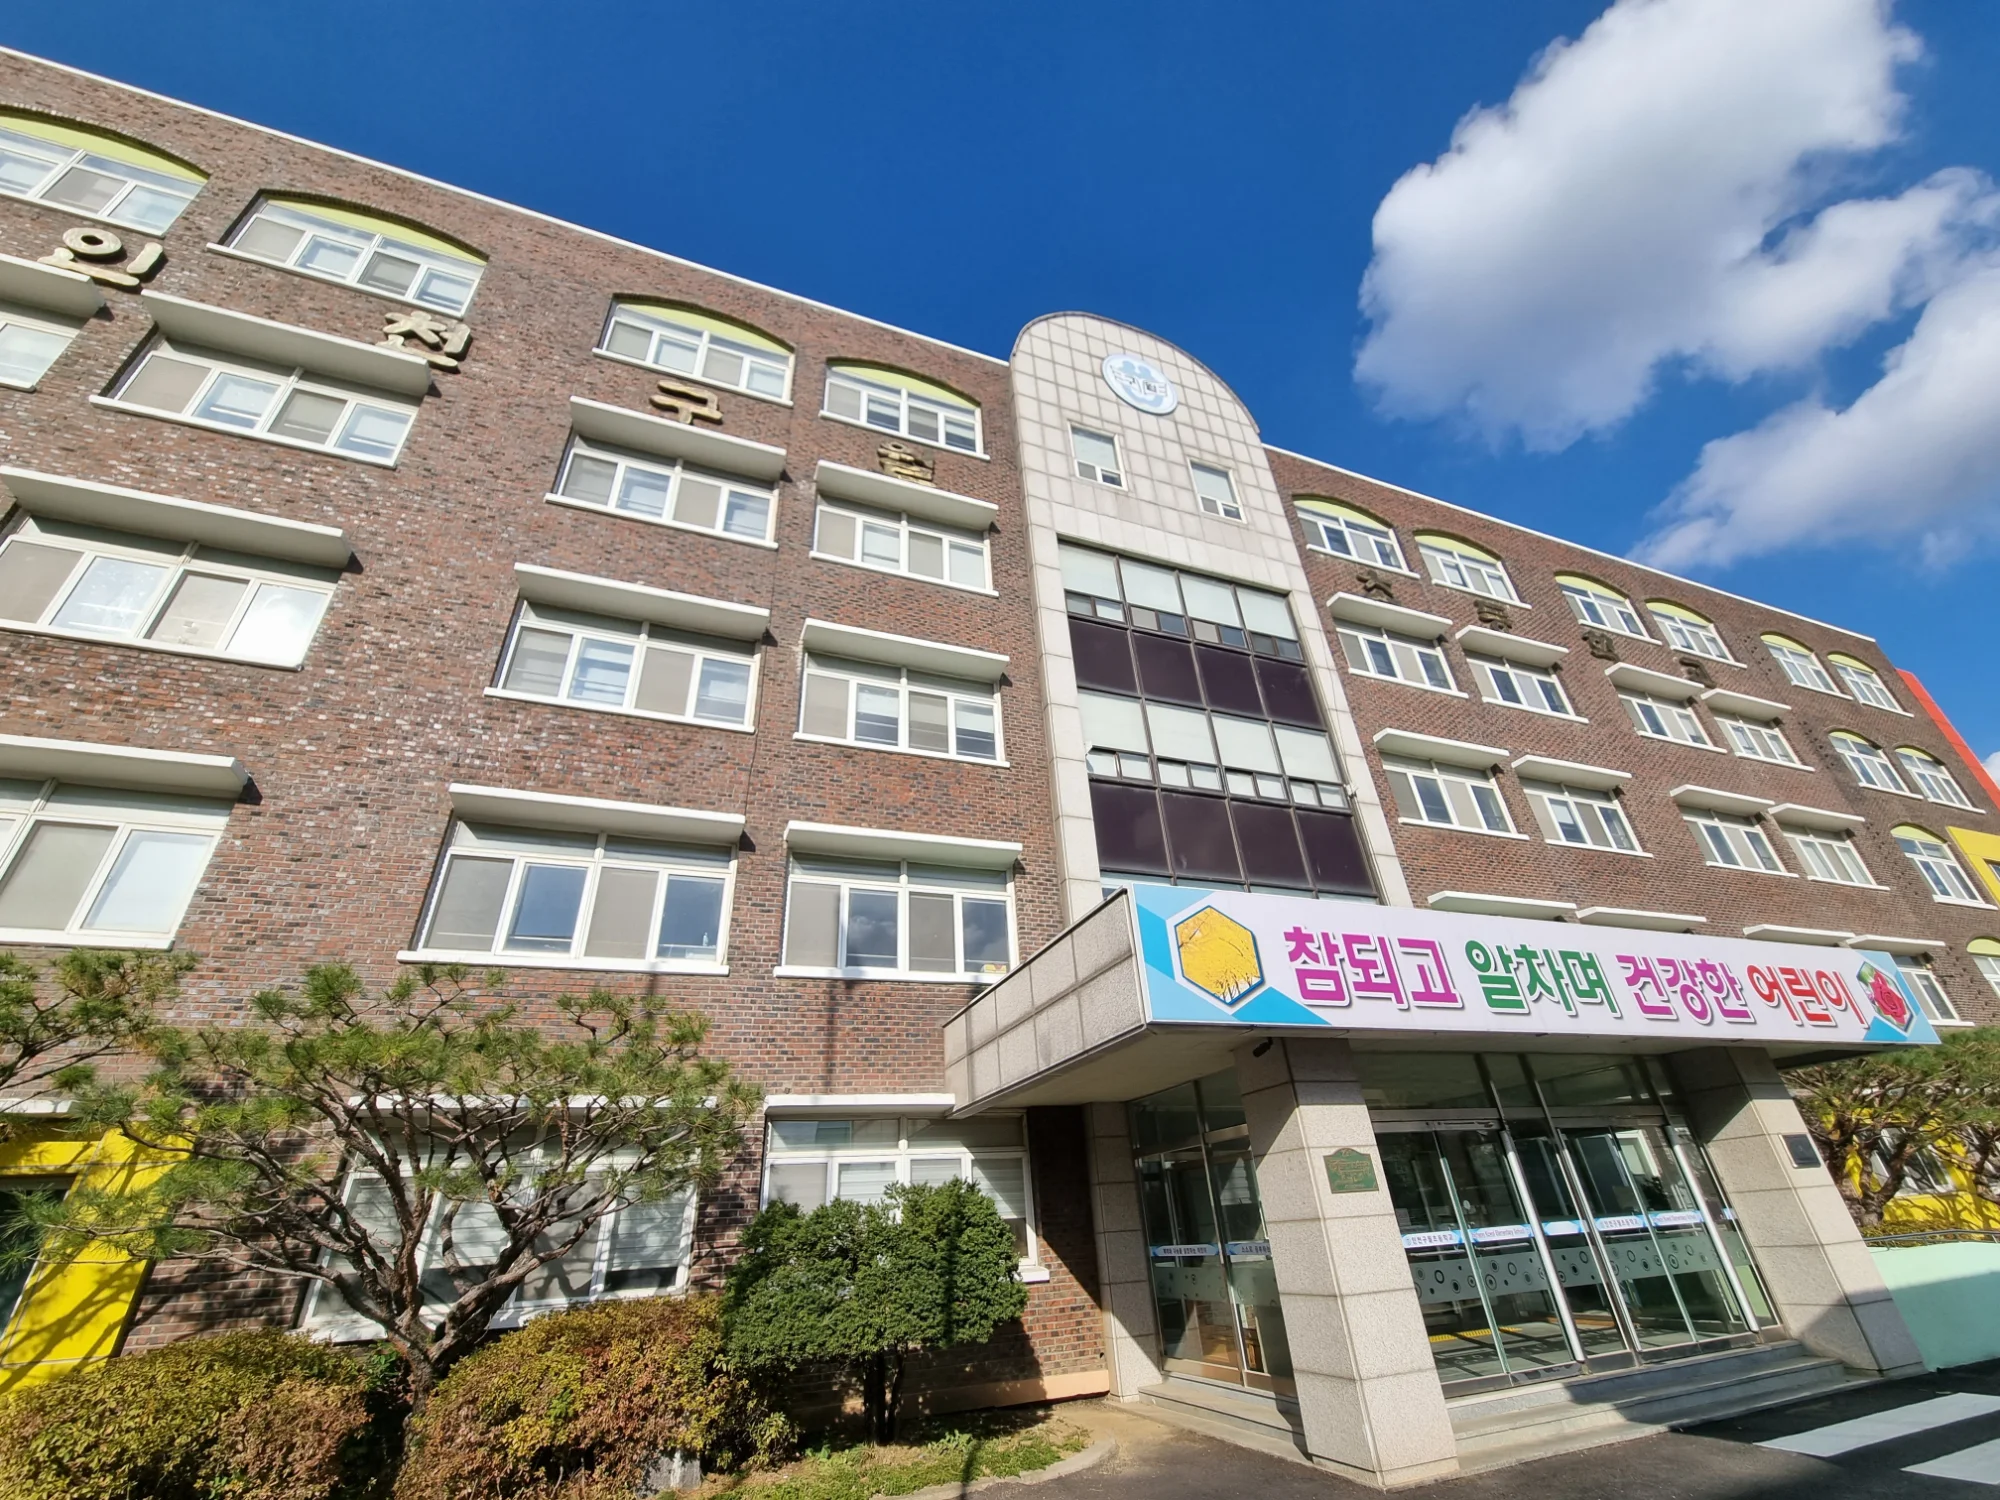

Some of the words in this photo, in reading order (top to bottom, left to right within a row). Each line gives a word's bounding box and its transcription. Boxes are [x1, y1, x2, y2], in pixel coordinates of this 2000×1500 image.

[1283, 925, 1463, 1010] 참되고
[1464, 940, 1622, 1018] 알차며
[1615, 953, 1756, 1024] 건강한
[1746, 963, 1869, 1029] 어린이
[1411, 1233, 1454, 1245] 인천구월초등학교
